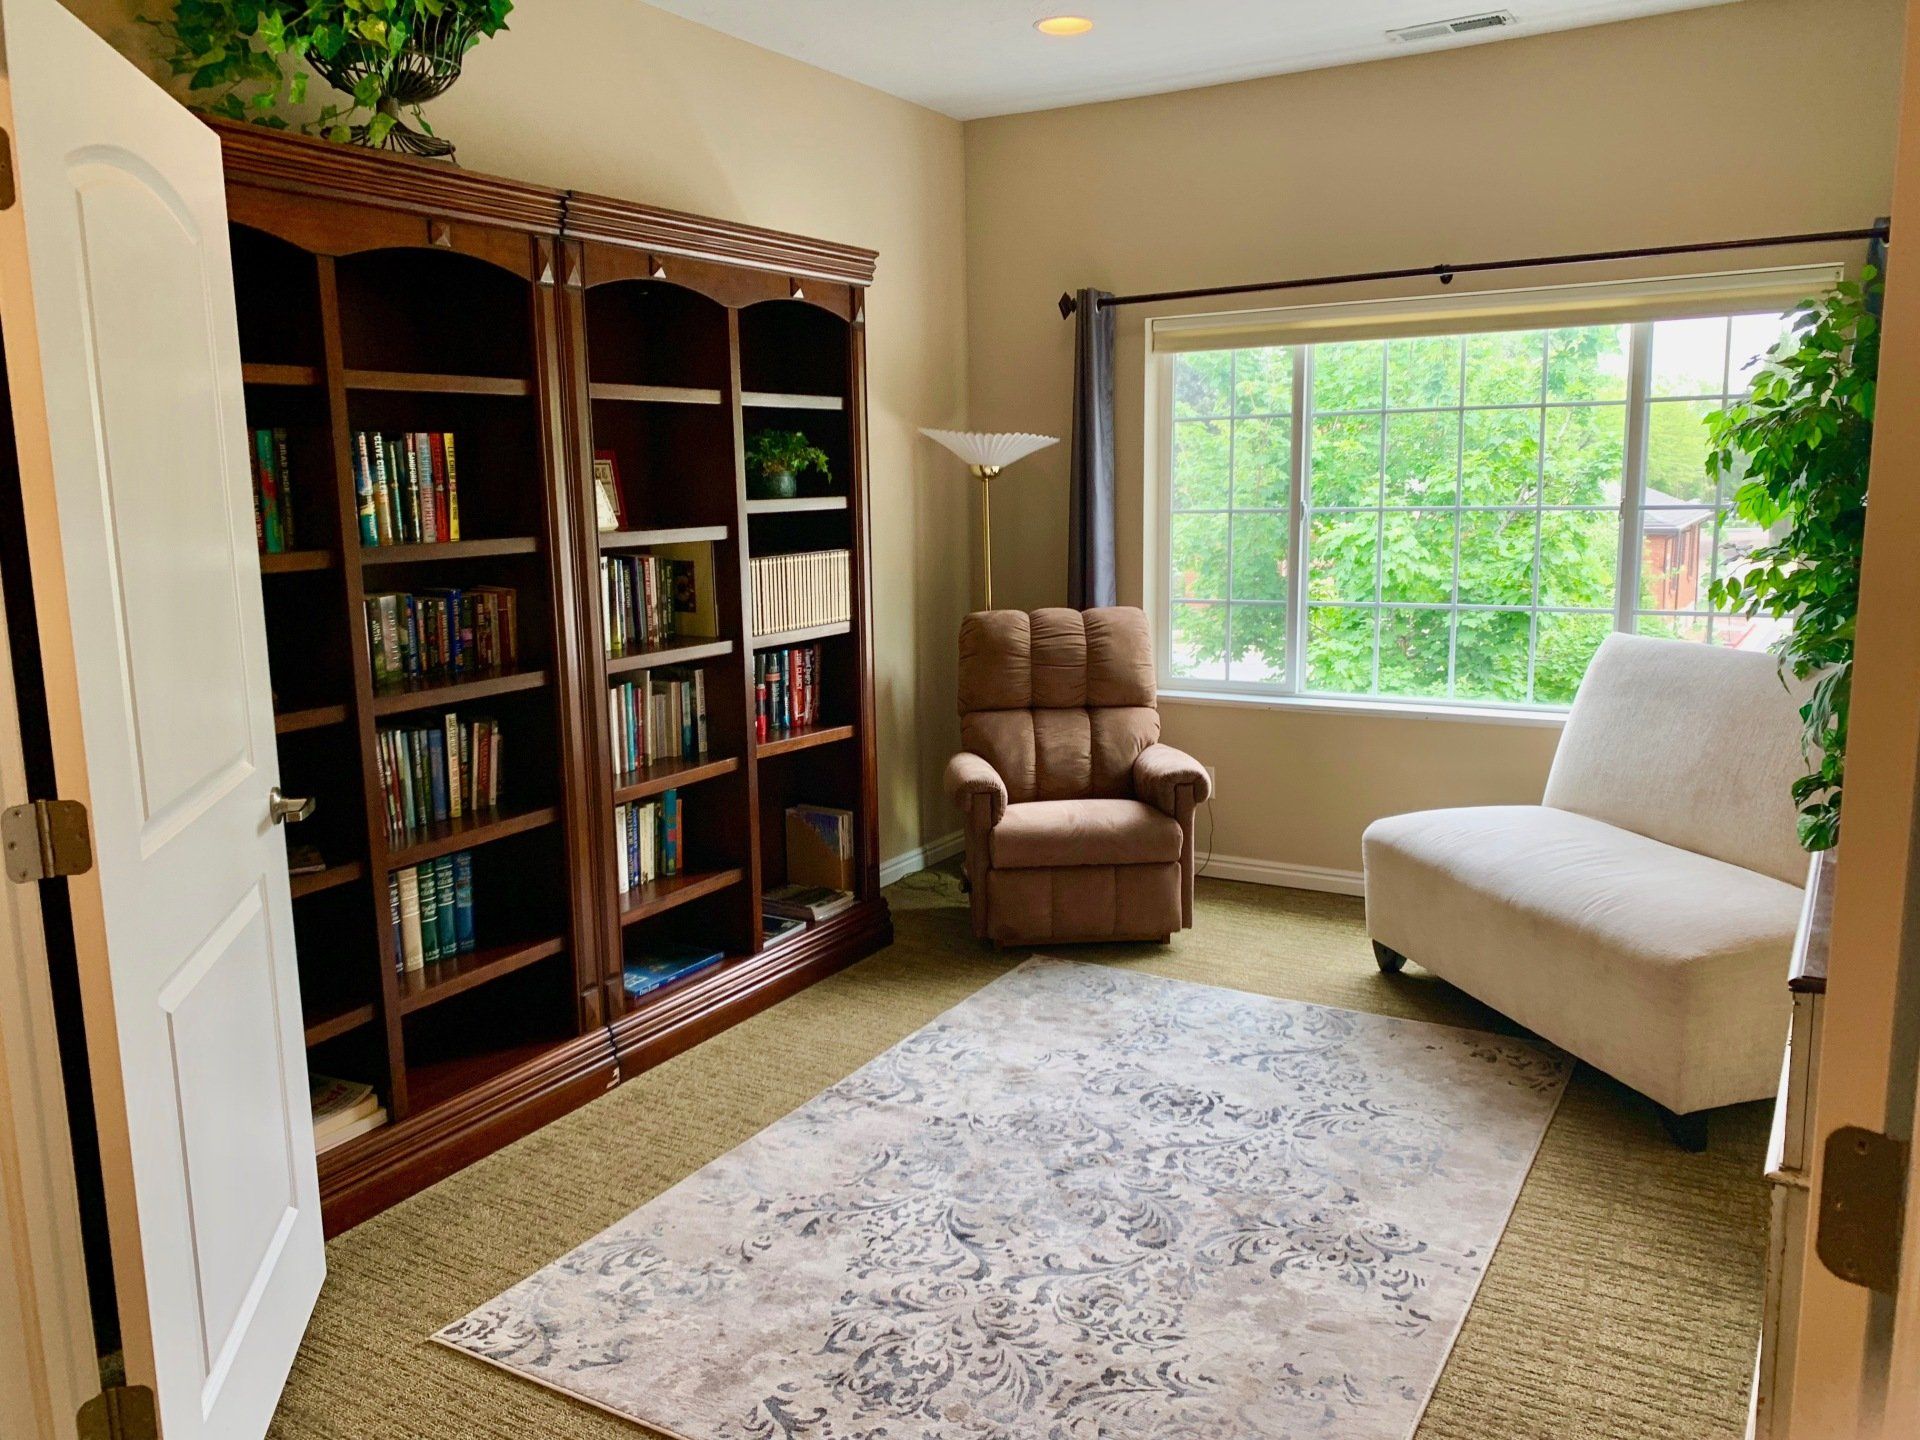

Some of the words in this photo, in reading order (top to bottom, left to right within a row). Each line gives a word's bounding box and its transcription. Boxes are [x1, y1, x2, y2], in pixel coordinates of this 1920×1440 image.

[374, 435, 384, 458] CLIVE
[377, 459, 387, 495] CUSSLER
[408, 452, 417, 483] SANDFORD
